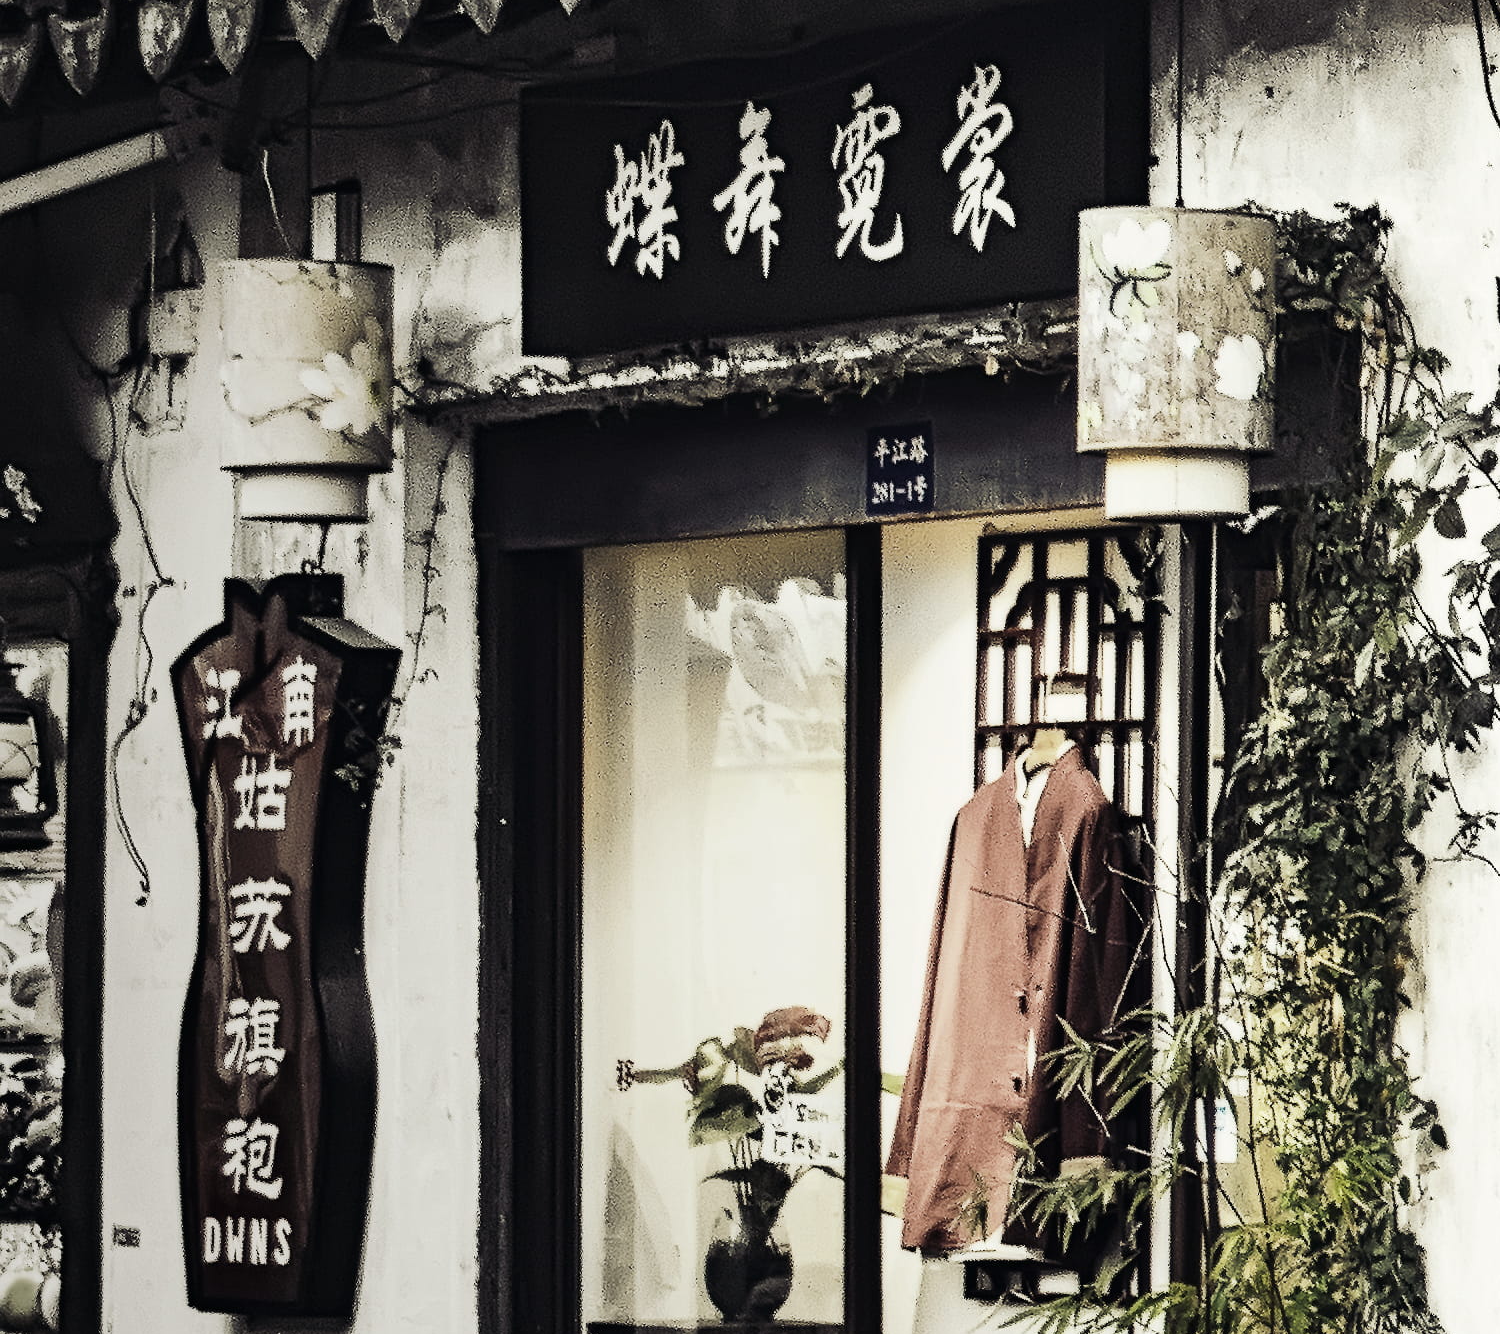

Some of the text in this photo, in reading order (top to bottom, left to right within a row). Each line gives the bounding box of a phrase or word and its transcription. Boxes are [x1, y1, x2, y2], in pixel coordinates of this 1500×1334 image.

[605, 64, 1017, 280] 蝶舞霓裳
[223, 752, 293, 1201] 姑苏旗袍
[203, 1215, 293, 1266] DWNS
